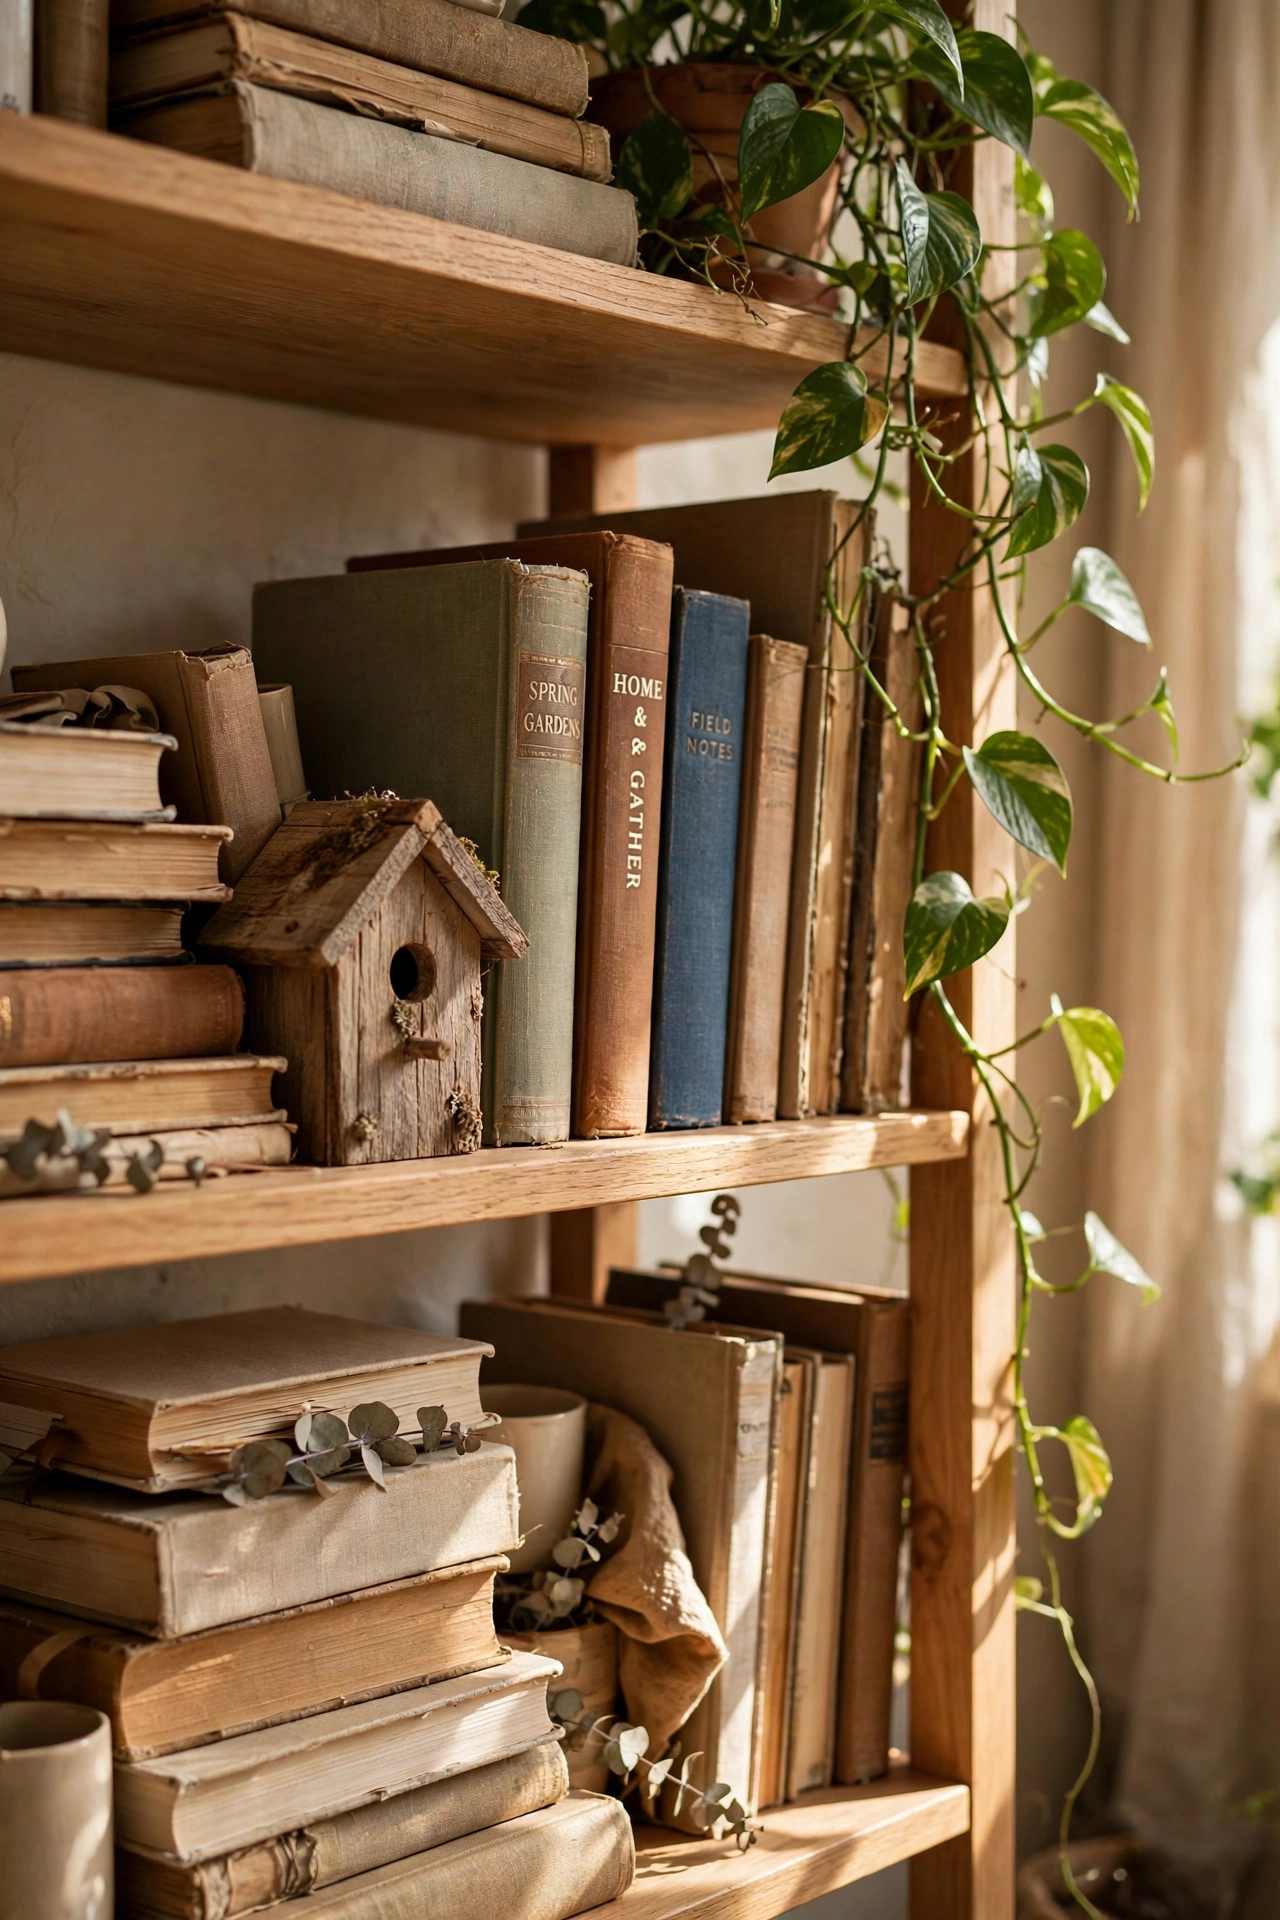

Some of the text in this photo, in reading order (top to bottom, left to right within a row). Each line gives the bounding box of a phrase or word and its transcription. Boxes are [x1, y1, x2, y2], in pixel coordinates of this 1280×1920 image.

[529, 681, 578, 706] SPRING
[613, 673, 663, 700] HOME
[524, 712, 580, 739] GARDENS
[634, 706, 647, 728] &
[691, 711, 732, 735] FIELD
[687, 737, 733, 760] NOTES
[626, 737, 647, 889] & GATHER
